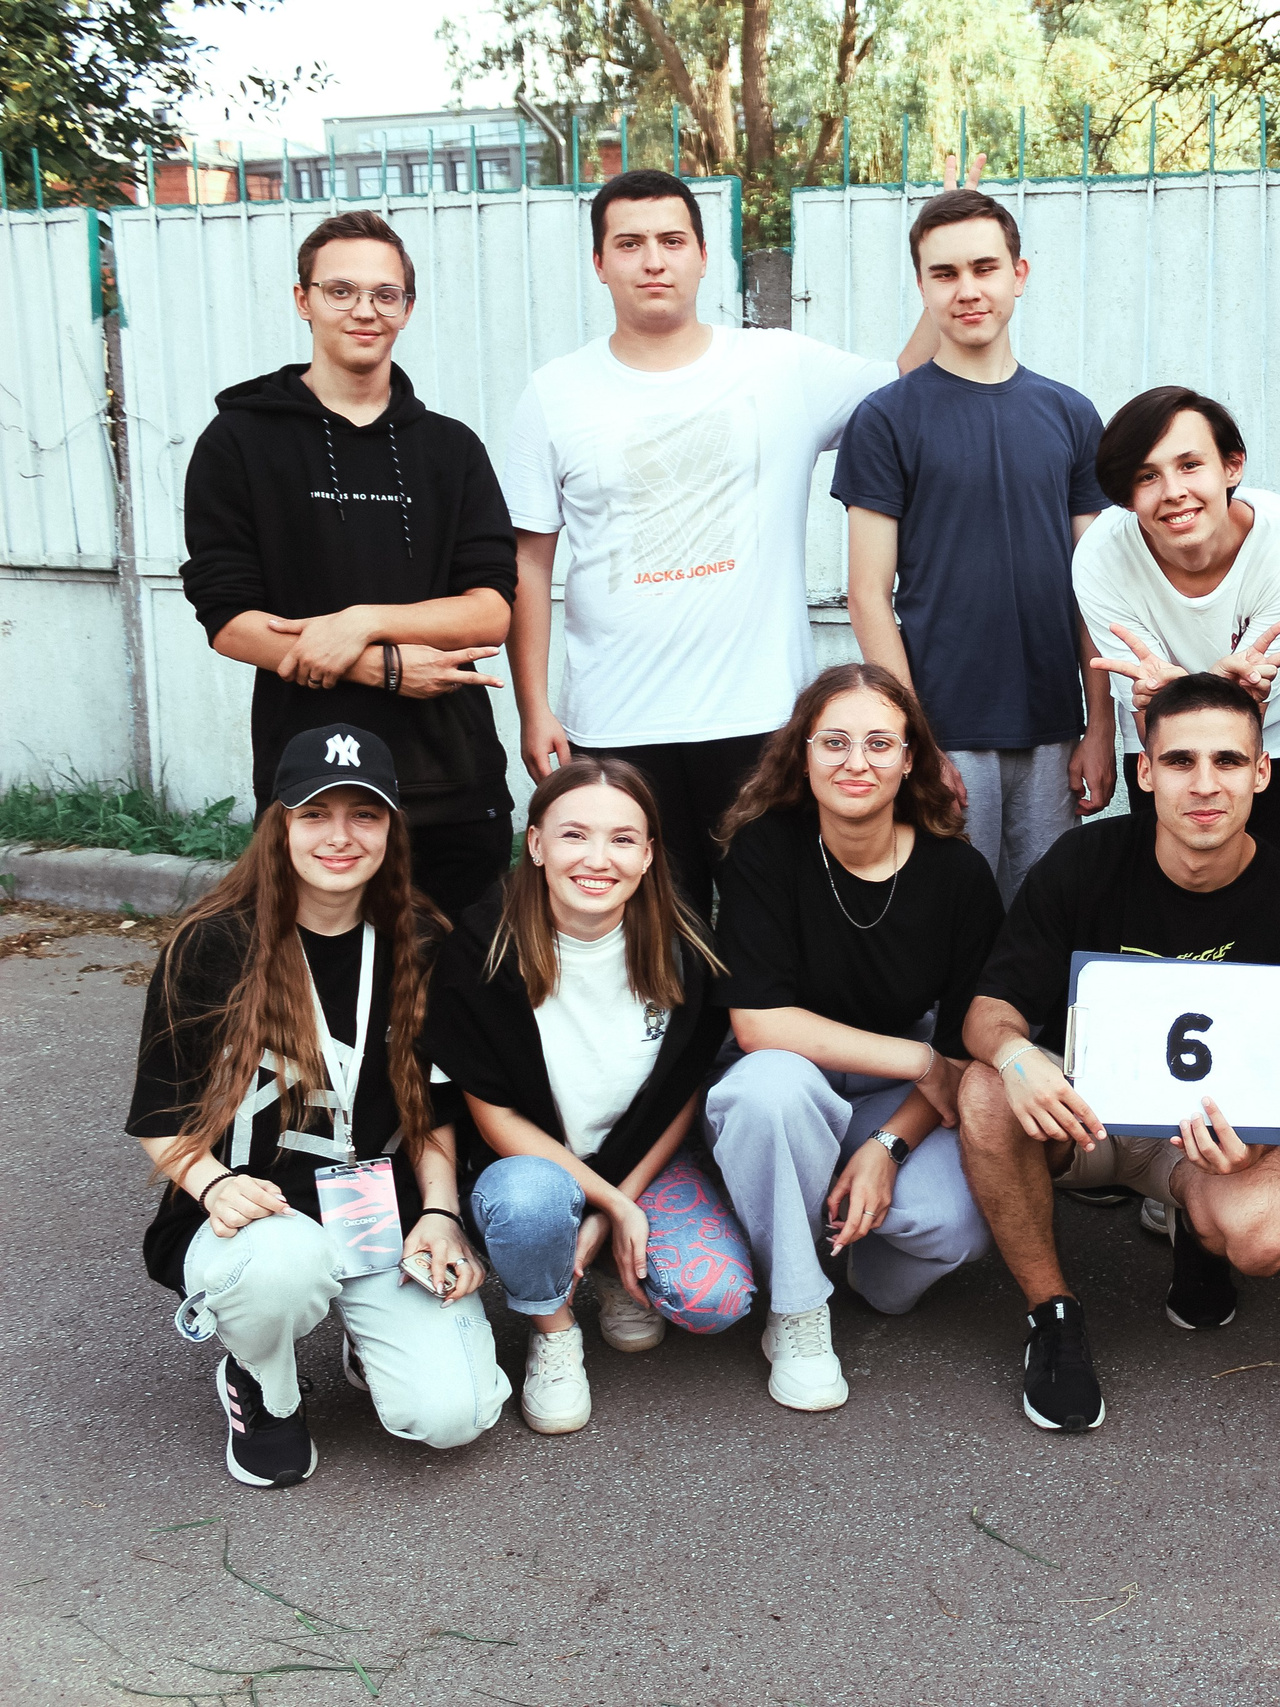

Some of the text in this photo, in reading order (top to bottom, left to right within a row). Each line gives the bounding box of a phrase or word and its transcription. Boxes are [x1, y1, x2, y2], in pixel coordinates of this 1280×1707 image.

[340, 492, 349, 500] IS
[370, 494, 403, 502] PLANE
[324, 733, 362, 768] NY
[1166, 1012, 1214, 1082] 6
[343, 1216, 377, 1228] Оксана
